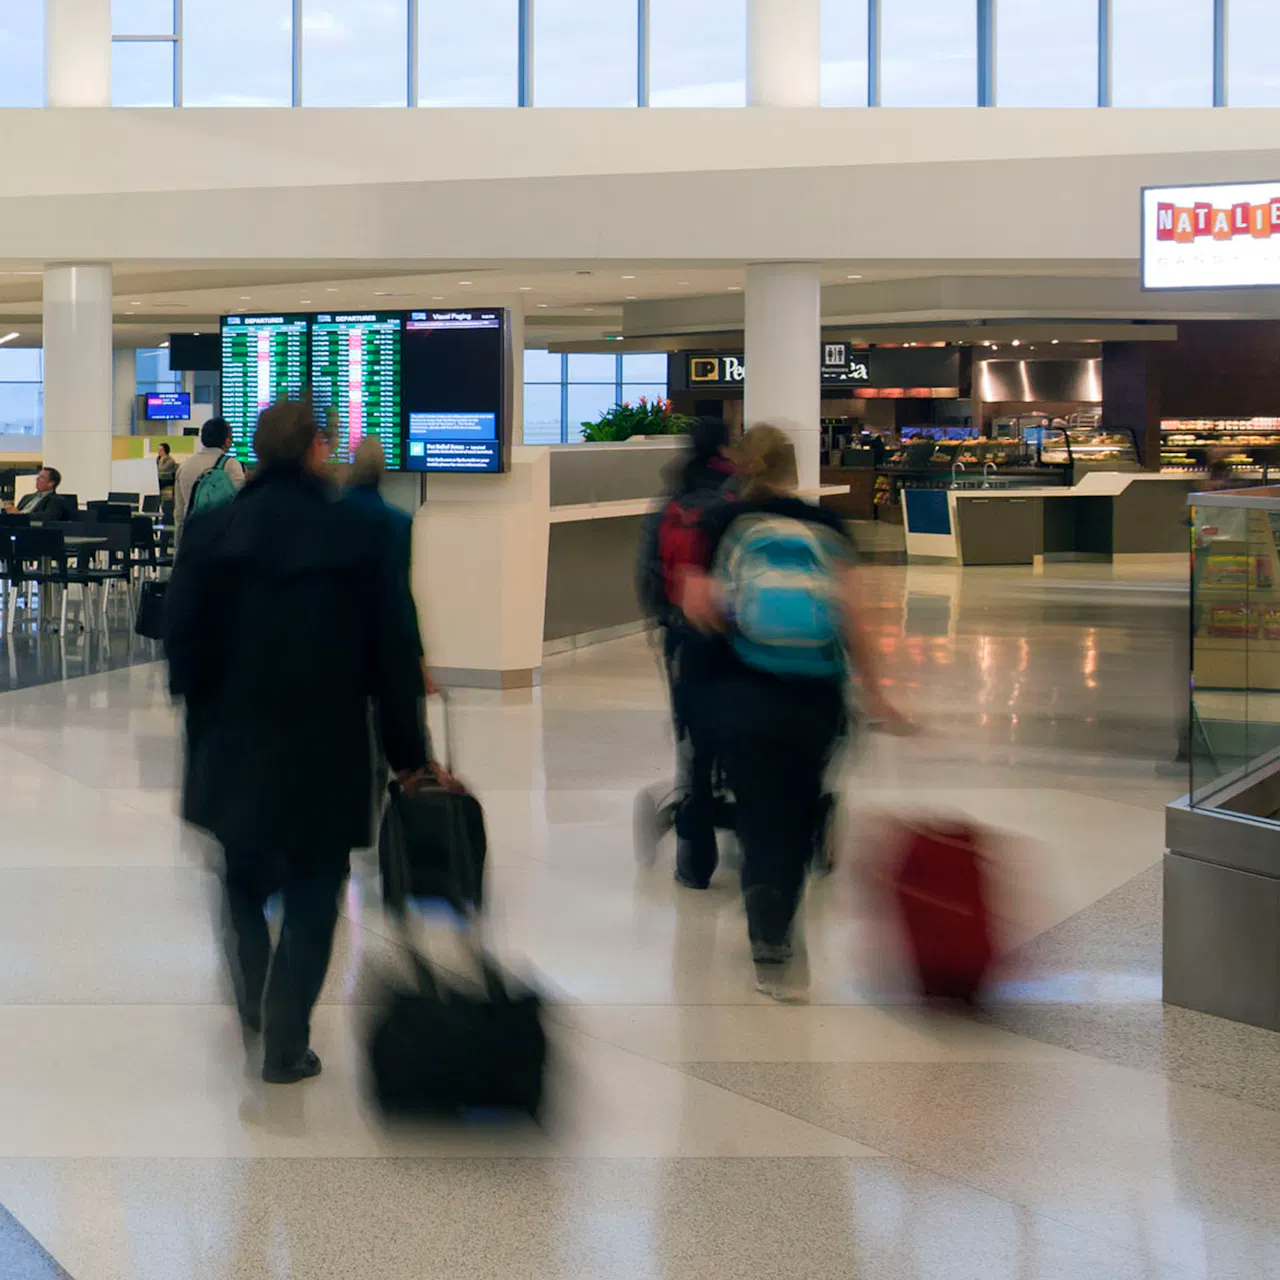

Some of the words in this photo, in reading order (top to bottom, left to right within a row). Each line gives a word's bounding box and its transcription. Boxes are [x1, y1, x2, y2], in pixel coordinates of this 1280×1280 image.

[244, 316, 284, 324] DEPARTURES
[335, 314, 376, 323] DEPARTURES
[451, 312, 472, 321] Paging
